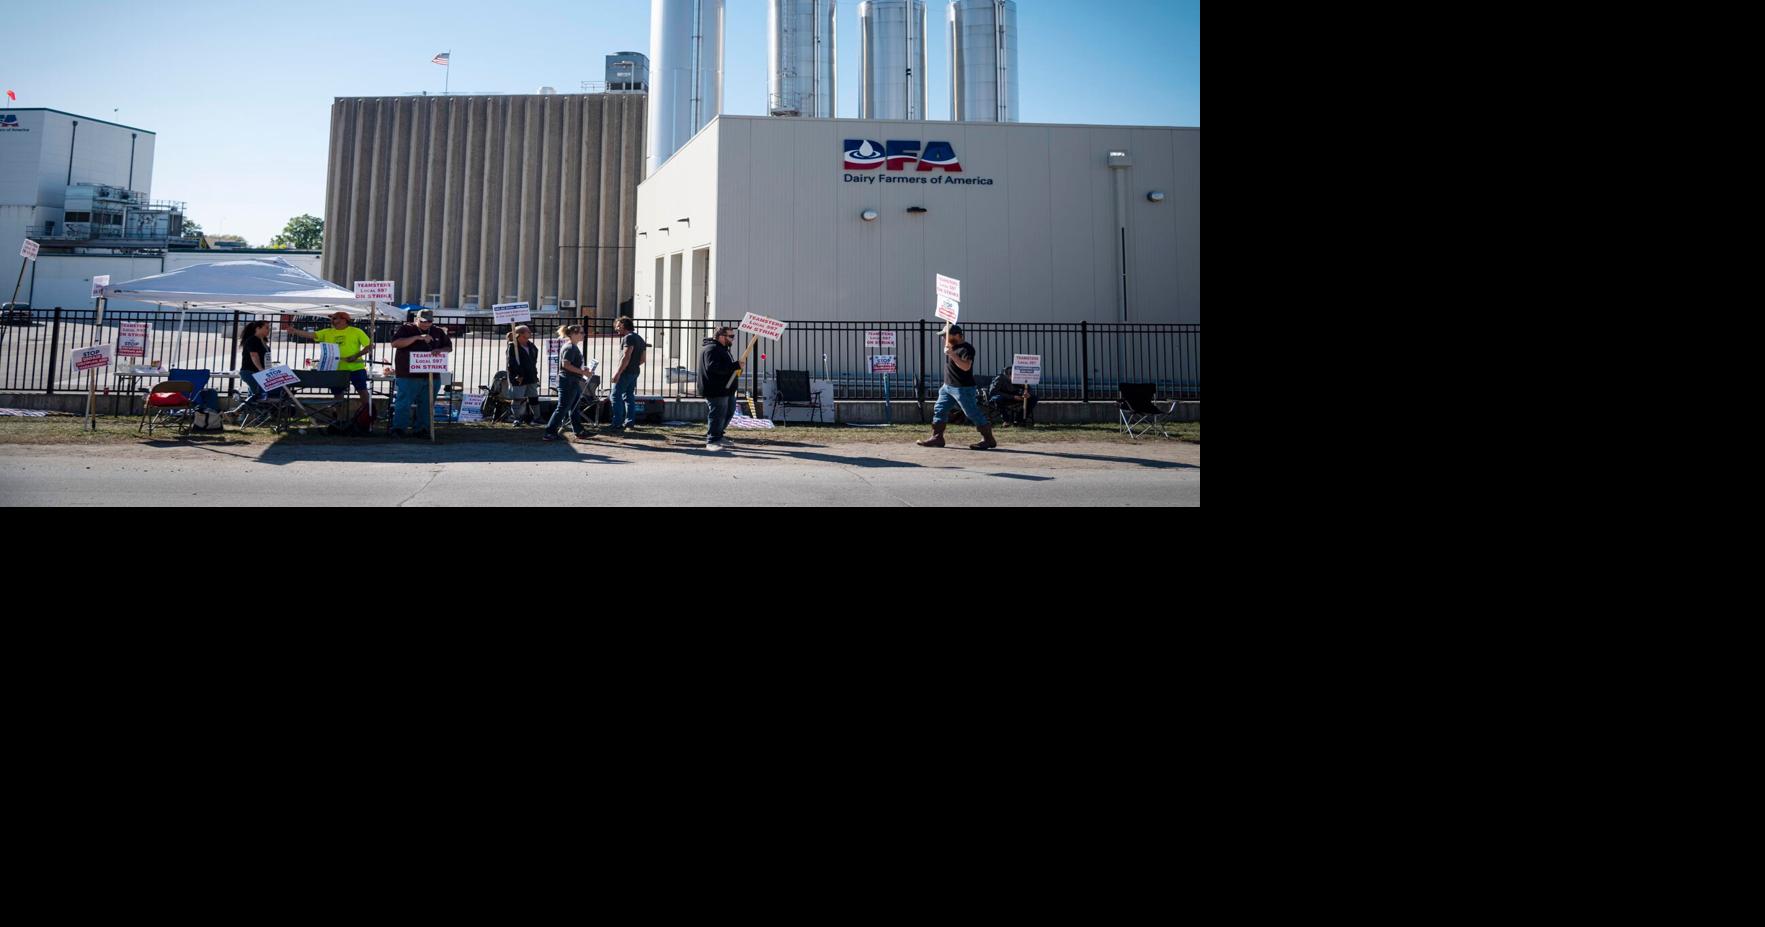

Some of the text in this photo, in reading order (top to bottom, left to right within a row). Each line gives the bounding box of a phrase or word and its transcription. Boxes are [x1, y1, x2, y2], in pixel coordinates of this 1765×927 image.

[844, 139, 962, 172] DFA
[844, 174, 993, 186] Dairy Farmers of America
[748, 315, 784, 328] TEAMSTERS
[754, 327, 780, 336] STRIKE
